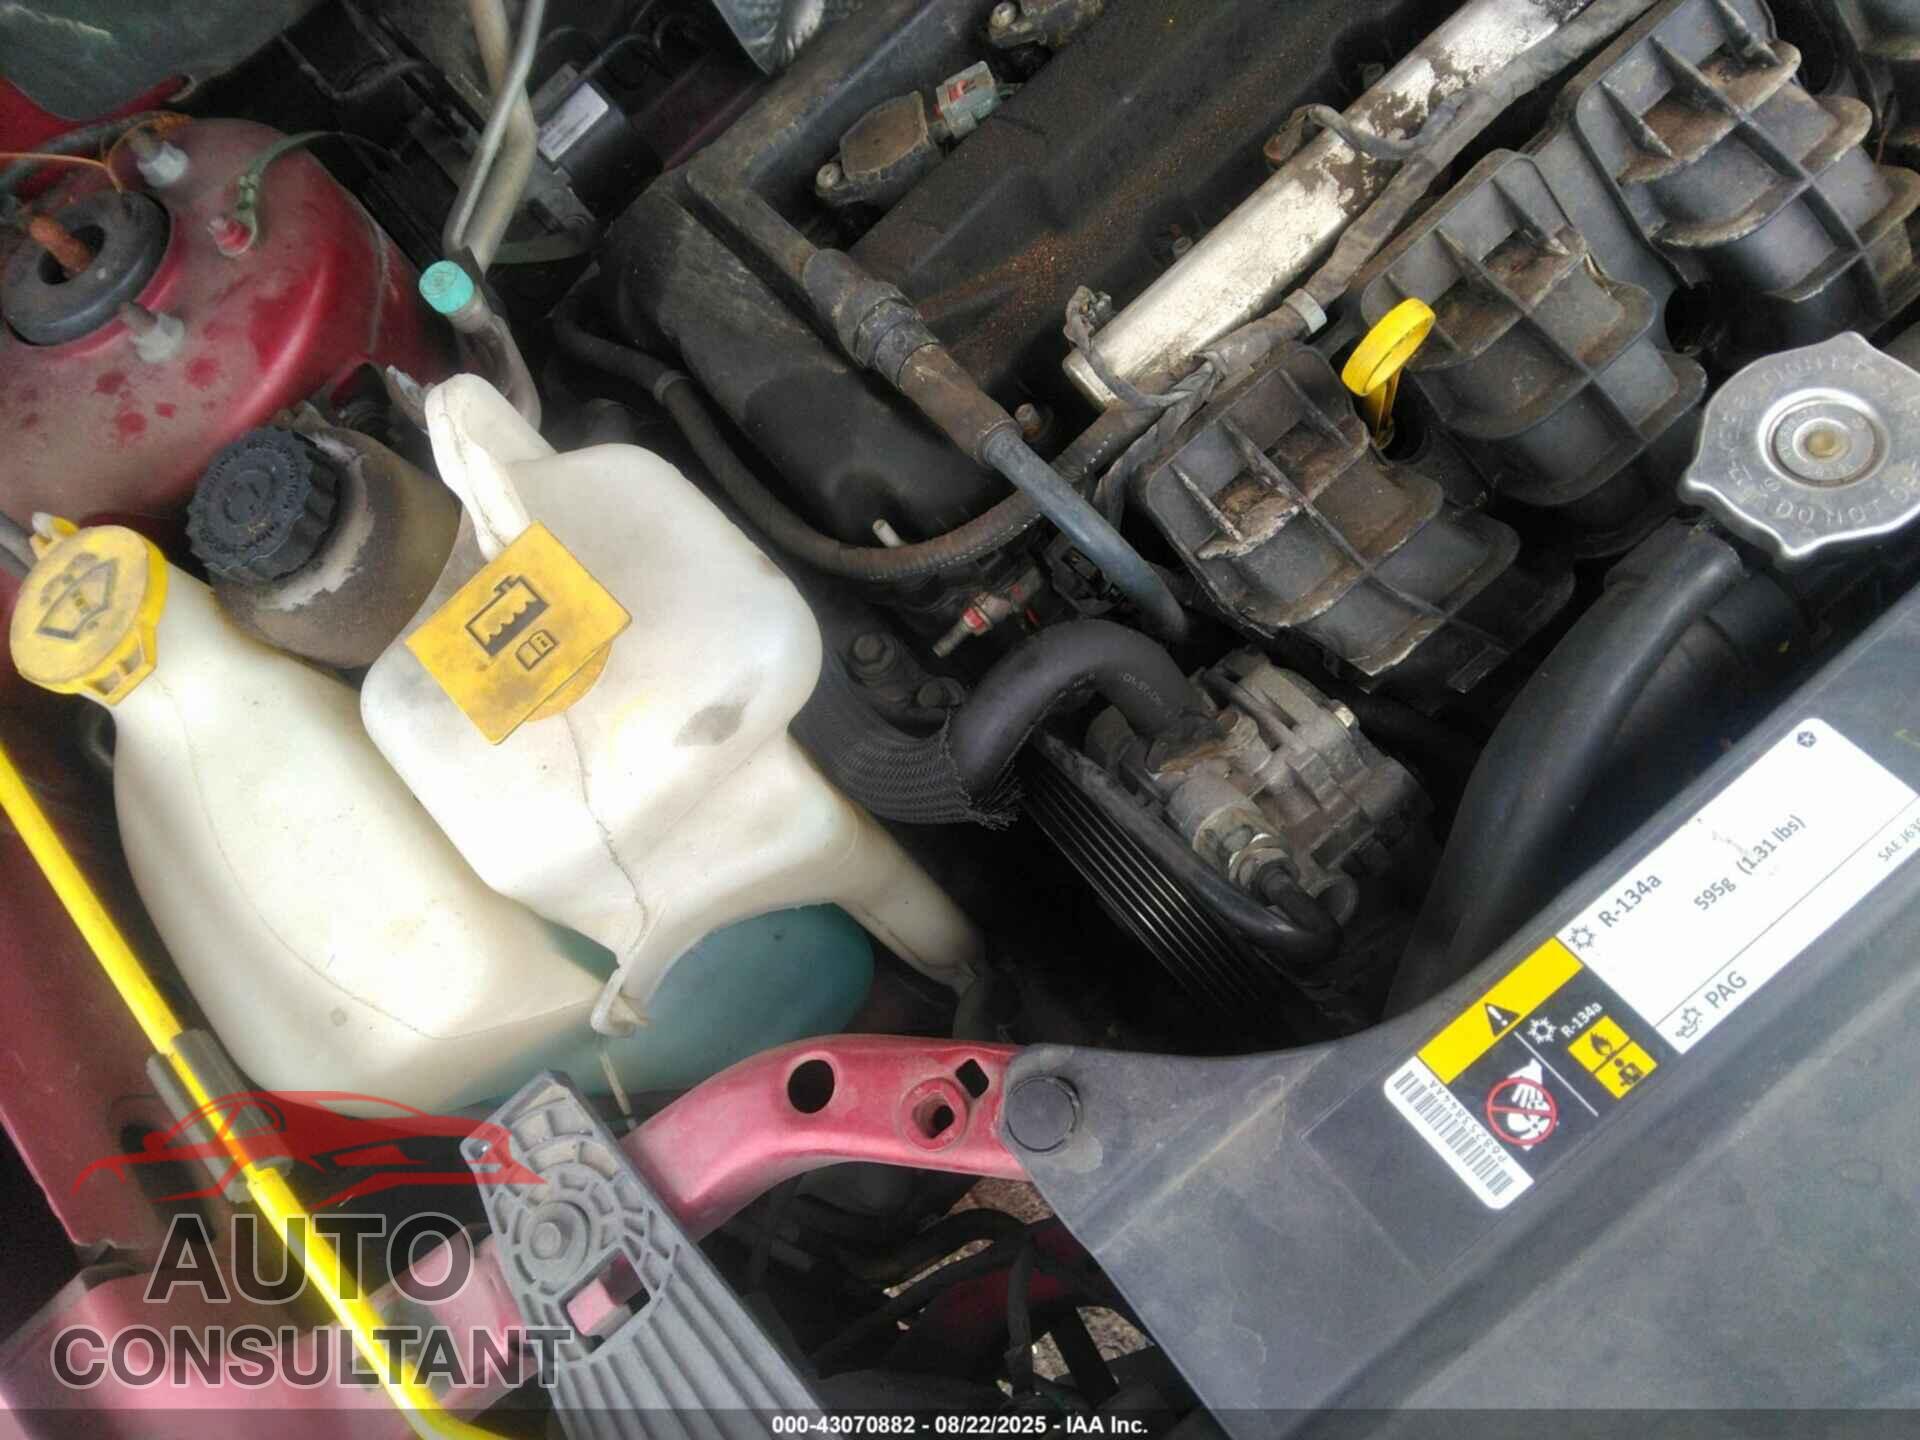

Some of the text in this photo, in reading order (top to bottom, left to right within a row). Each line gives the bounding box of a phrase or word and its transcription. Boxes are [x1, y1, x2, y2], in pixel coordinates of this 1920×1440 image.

[1694, 814, 1807, 911] 595g (1.31 lbs)
[1878, 840, 1902, 862] SAE
[1597, 874, 1662, 928] R-134a
[1704, 970, 1747, 1009] PAG
[1560, 1002, 1603, 1039] R-134a
